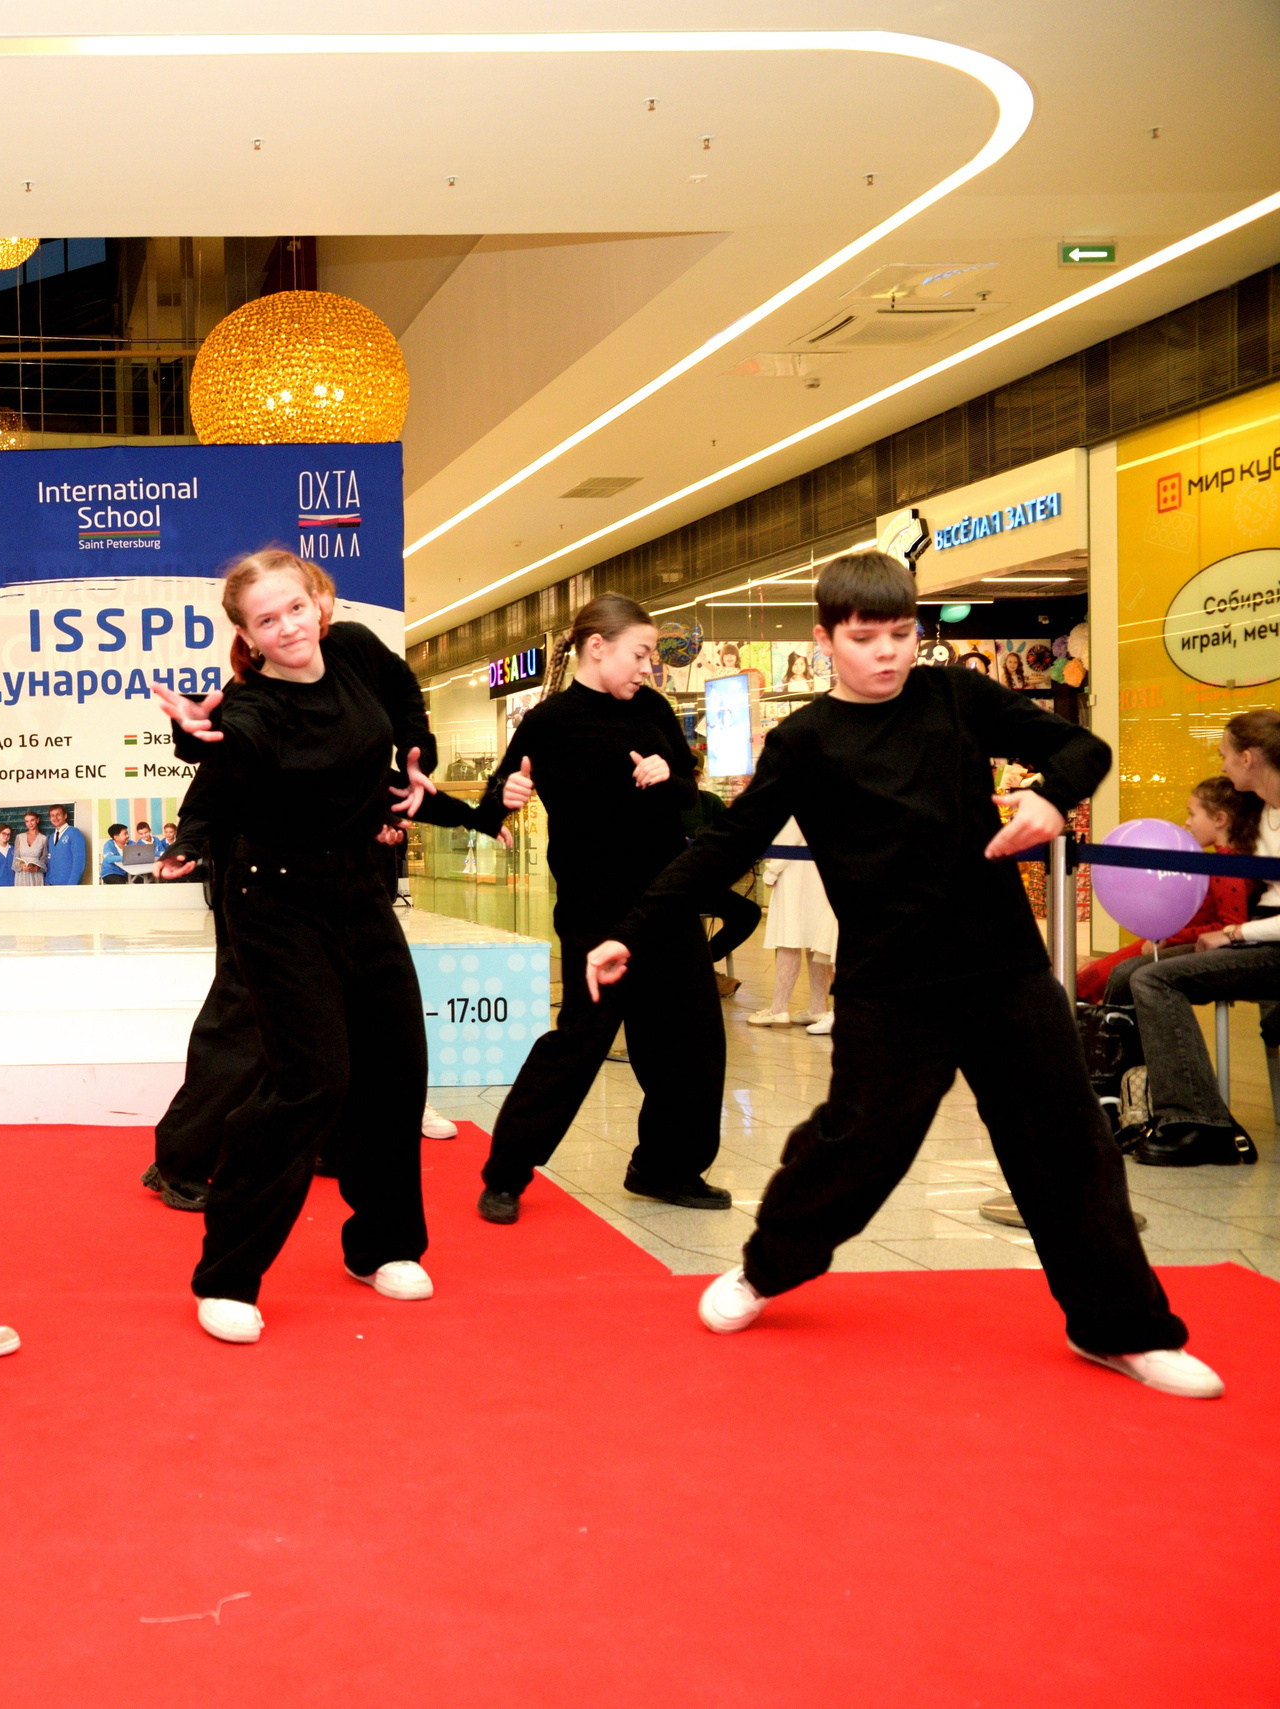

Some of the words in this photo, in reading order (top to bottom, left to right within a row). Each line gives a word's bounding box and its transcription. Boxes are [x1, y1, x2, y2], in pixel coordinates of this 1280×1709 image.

[37, 476, 198, 503] International
[299, 469, 361, 511] ОХТА
[1188, 467, 1235, 496] мир
[77, 504, 162, 530] School
[934, 511, 1004, 551] ВЕСЁЛАЯ
[1004, 492, 1062, 531] ЗАТЕЯ
[78, 539, 105, 551] Saint
[106, 537, 162, 551] Petersburg
[300, 532, 361, 559] МОЛЛ
[28, 604, 215, 652] ISSPb
[1181, 622, 1238, 654] играй,
[489, 647, 537, 689] DESALU
[18, 733, 39, 748] 16
[44, 735, 72, 748] лет
[75, 764, 107, 779] ENC
[446, 996, 508, 1023] 17:00
